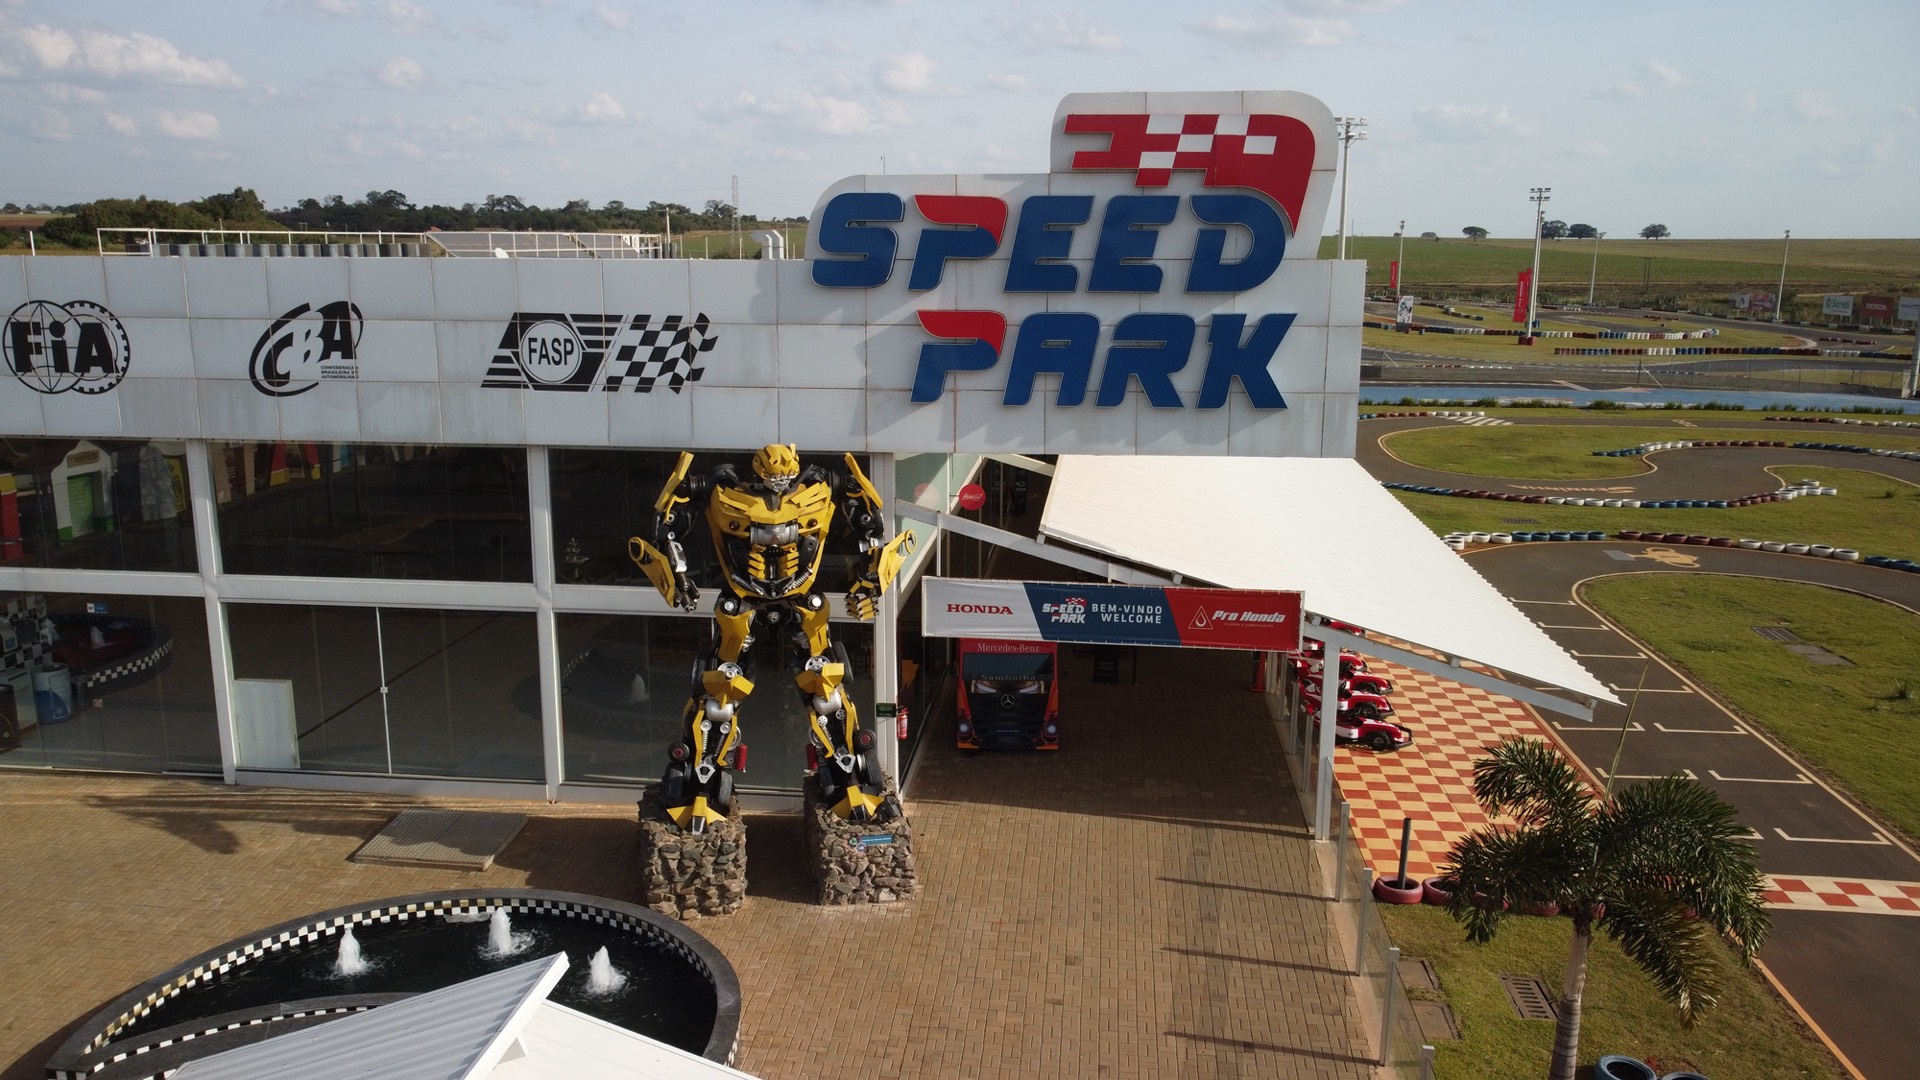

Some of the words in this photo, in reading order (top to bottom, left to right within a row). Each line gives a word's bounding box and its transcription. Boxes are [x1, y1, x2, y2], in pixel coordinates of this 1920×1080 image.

[811, 192, 1286, 294] SPEED
[262, 300, 358, 387] CBA
[528, 337, 574, 366] FASP
[910, 310, 1298, 410] PARK
[947, 604, 1013, 615] HONDA
[1042, 603, 1085, 614] SPEED
[1091, 603, 1163, 614] BEM-VINDO
[1050, 613, 1086, 624] PARK
[1101, 613, 1162, 624] WELCOME
[1212, 610, 1239, 621] Pro
[1239, 611, 1286, 623] Honda
[977, 643, 1040, 653] Mercedes-Benz
